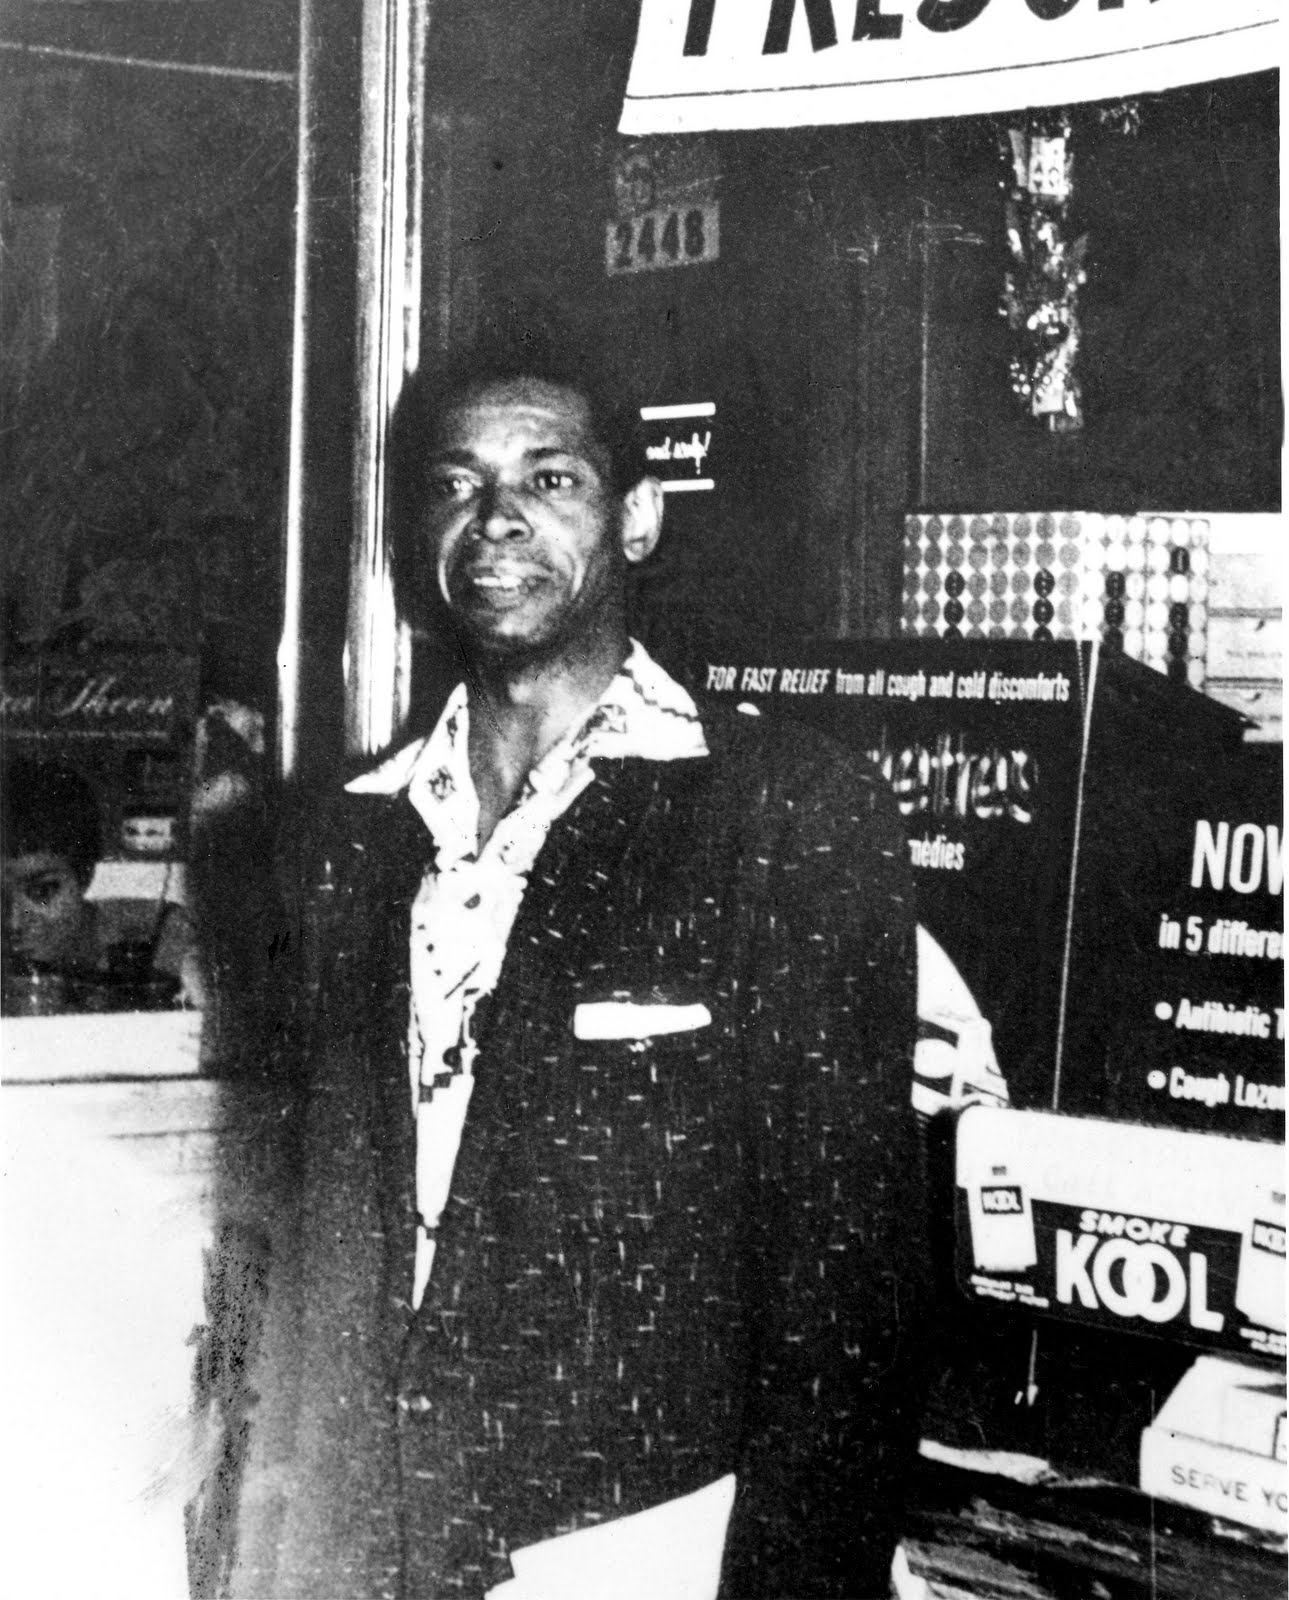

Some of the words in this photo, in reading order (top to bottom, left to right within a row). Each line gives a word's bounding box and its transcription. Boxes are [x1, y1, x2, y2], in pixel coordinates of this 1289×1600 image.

[706, 664, 737, 691] FOR
[741, 666, 777, 693] FAST
[779, 667, 830, 694] RELIEF
[835, 667, 865, 695] from
[867, 668, 885, 696] all
[887, 669, 926, 701] cough
[929, 671, 954, 697] and
[956, 670, 987, 699] cold
[988, 671, 1070, 701] discomforts
[1158, 913, 1181, 949] in
[1185, 916, 1203, 951] 5
[1175, 998, 1271, 1039] Antibiotic
[1169, 1066, 1230, 1108] Cough
[1079, 1210, 1190, 1248] SMOKE
[1055, 1228, 1225, 1332] KOOL
[1171, 1464, 1248, 1502] SERVE
